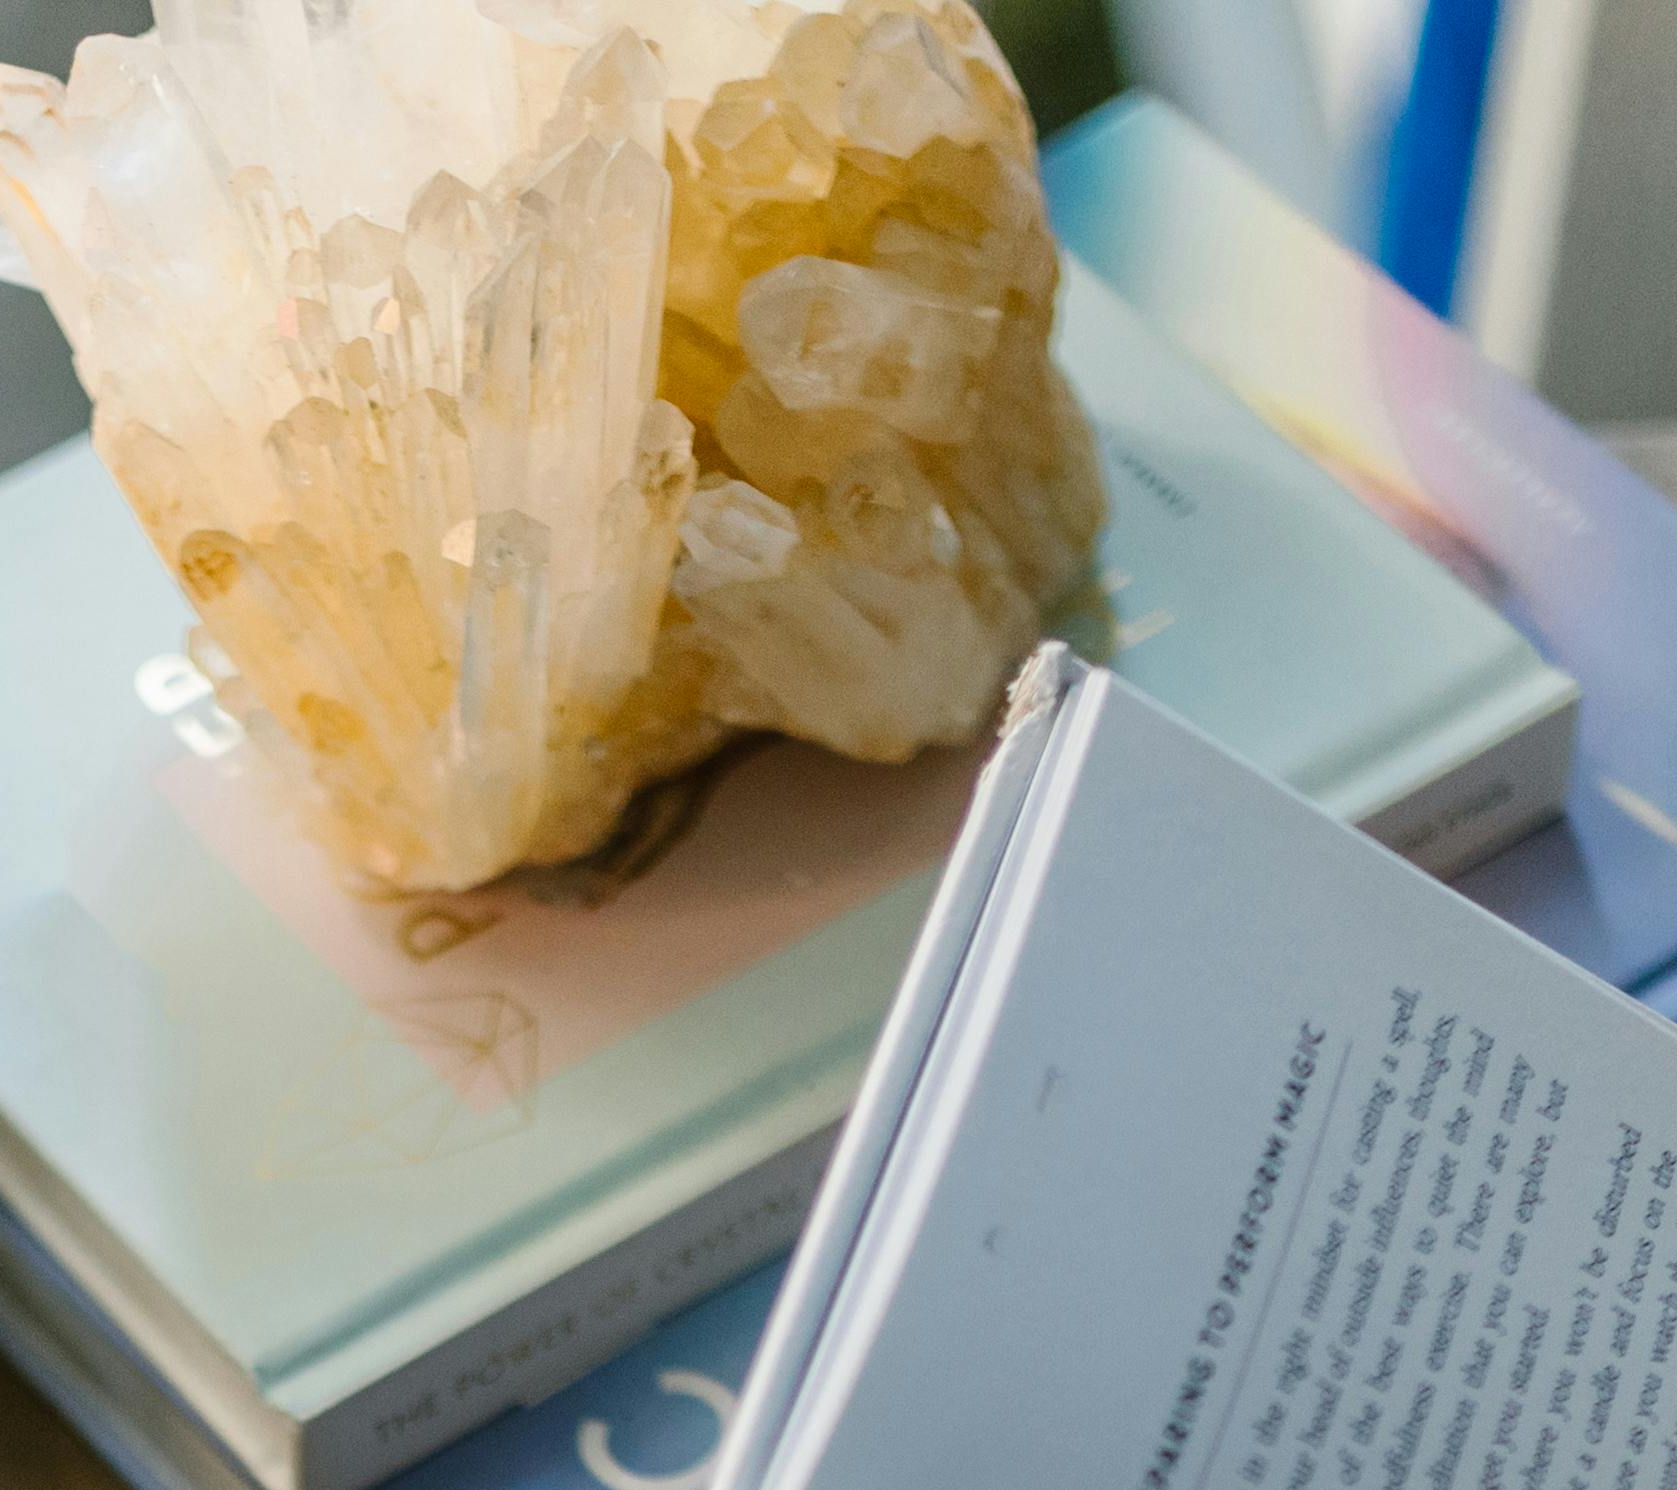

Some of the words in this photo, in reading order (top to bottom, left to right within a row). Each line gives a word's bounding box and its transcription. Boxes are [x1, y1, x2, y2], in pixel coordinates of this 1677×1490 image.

[1196, 1300, 1235, 1348] TO
[1218, 1134, 1287, 1296] PERFORM
[1274, 1020, 1326, 1130] MAGIC
[452, 1312, 580, 1401] POWER
